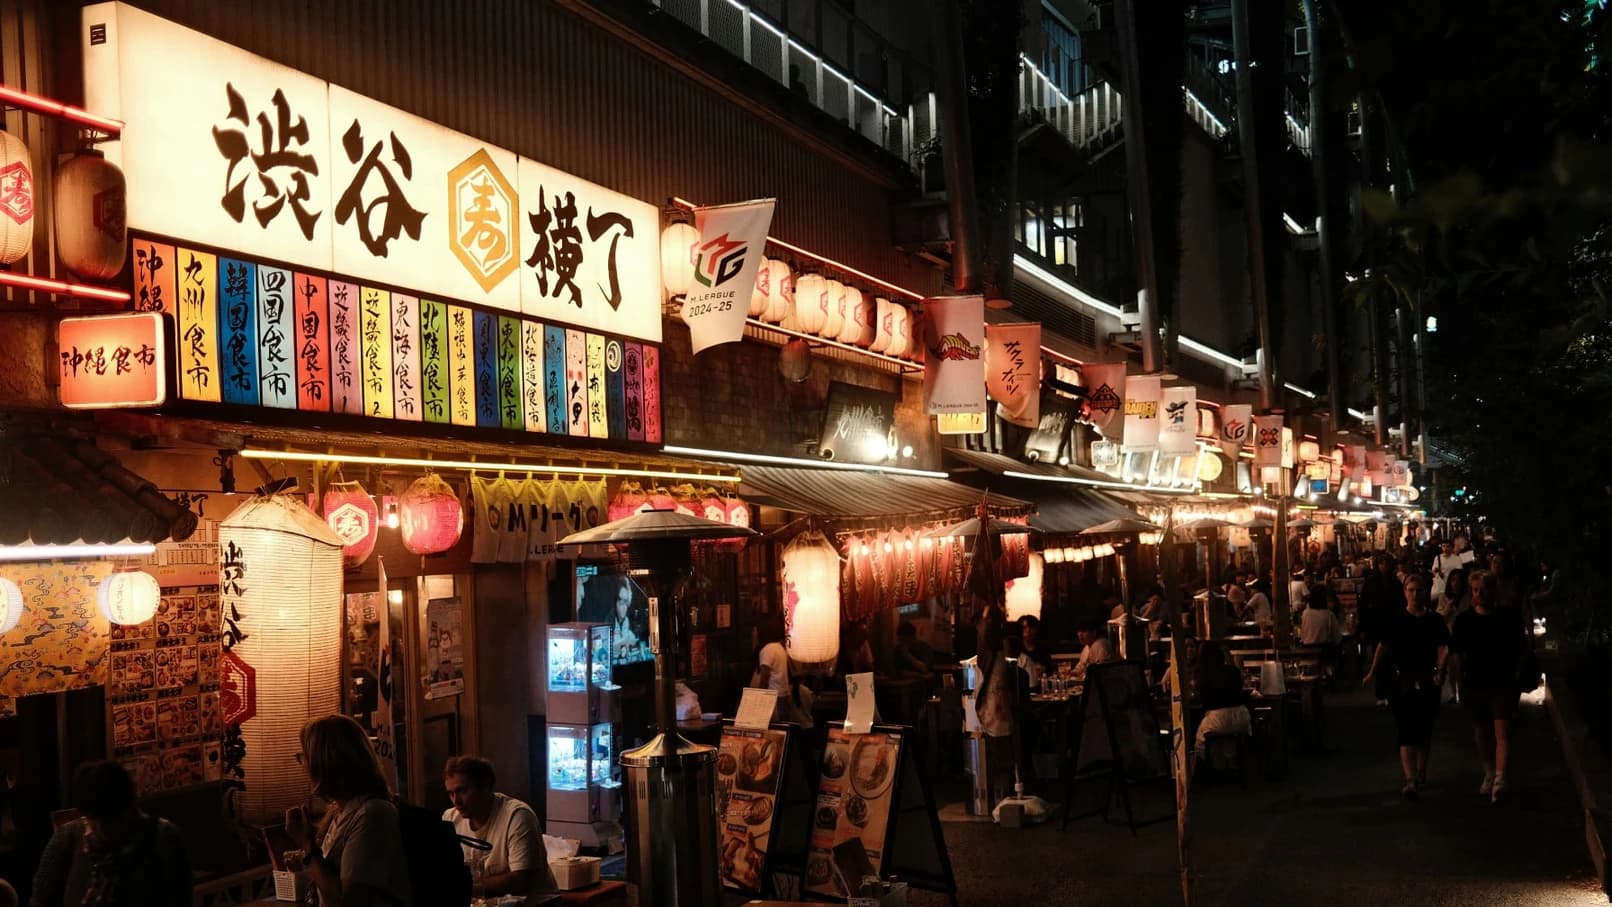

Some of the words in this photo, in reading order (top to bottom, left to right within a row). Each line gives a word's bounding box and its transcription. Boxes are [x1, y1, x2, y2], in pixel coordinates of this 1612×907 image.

[212, 82, 428, 258] 渋谷
[525, 184, 634, 312] 横丁
[61, 344, 156, 378] 沖縄食市
[184, 252, 211, 396] 九州食市
[224, 262, 251, 398] 韓国食市
[262, 270, 291, 404] 四国食市
[299, 277, 325, 408] 中国食市
[393, 301, 415, 415] 東海食市
[422, 303, 445, 420] 北陸食市
[689, 301, 732, 318] 2024-25
[1003, 340, 1025, 369] サクラ
[501, 320, 518, 425] 東北食市
[525, 323, 541, 427] 北海道食市
